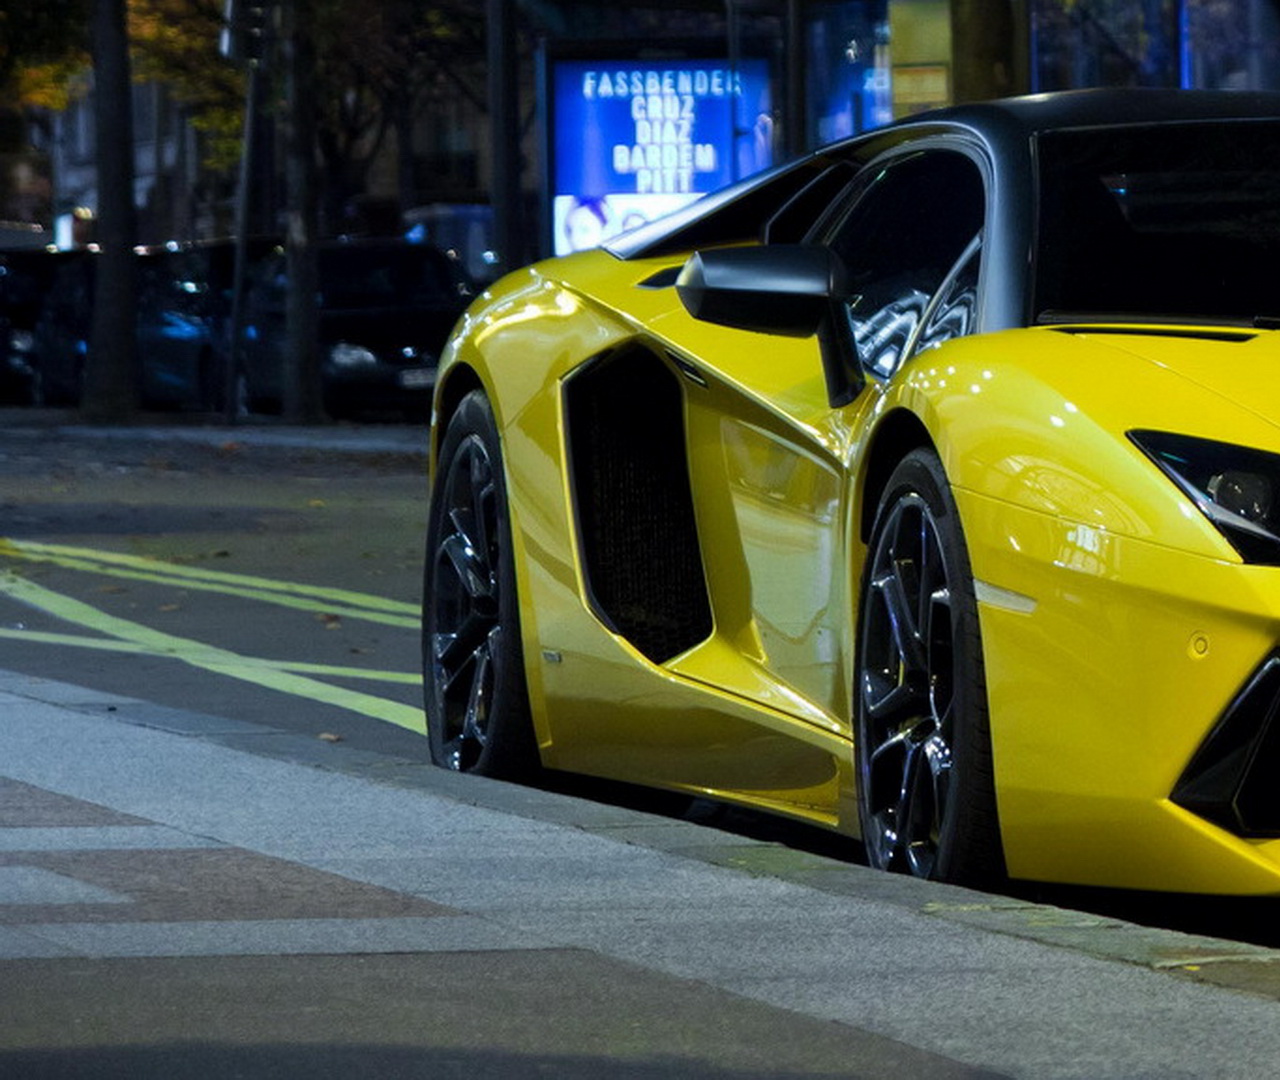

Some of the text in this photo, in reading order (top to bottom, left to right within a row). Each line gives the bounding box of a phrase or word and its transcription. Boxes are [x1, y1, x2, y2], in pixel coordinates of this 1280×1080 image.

[632, 95, 695, 121] CRUZ
[636, 120, 692, 145] DIAZ
[613, 144, 715, 173] BARDEM
[637, 168, 693, 193] PITT
